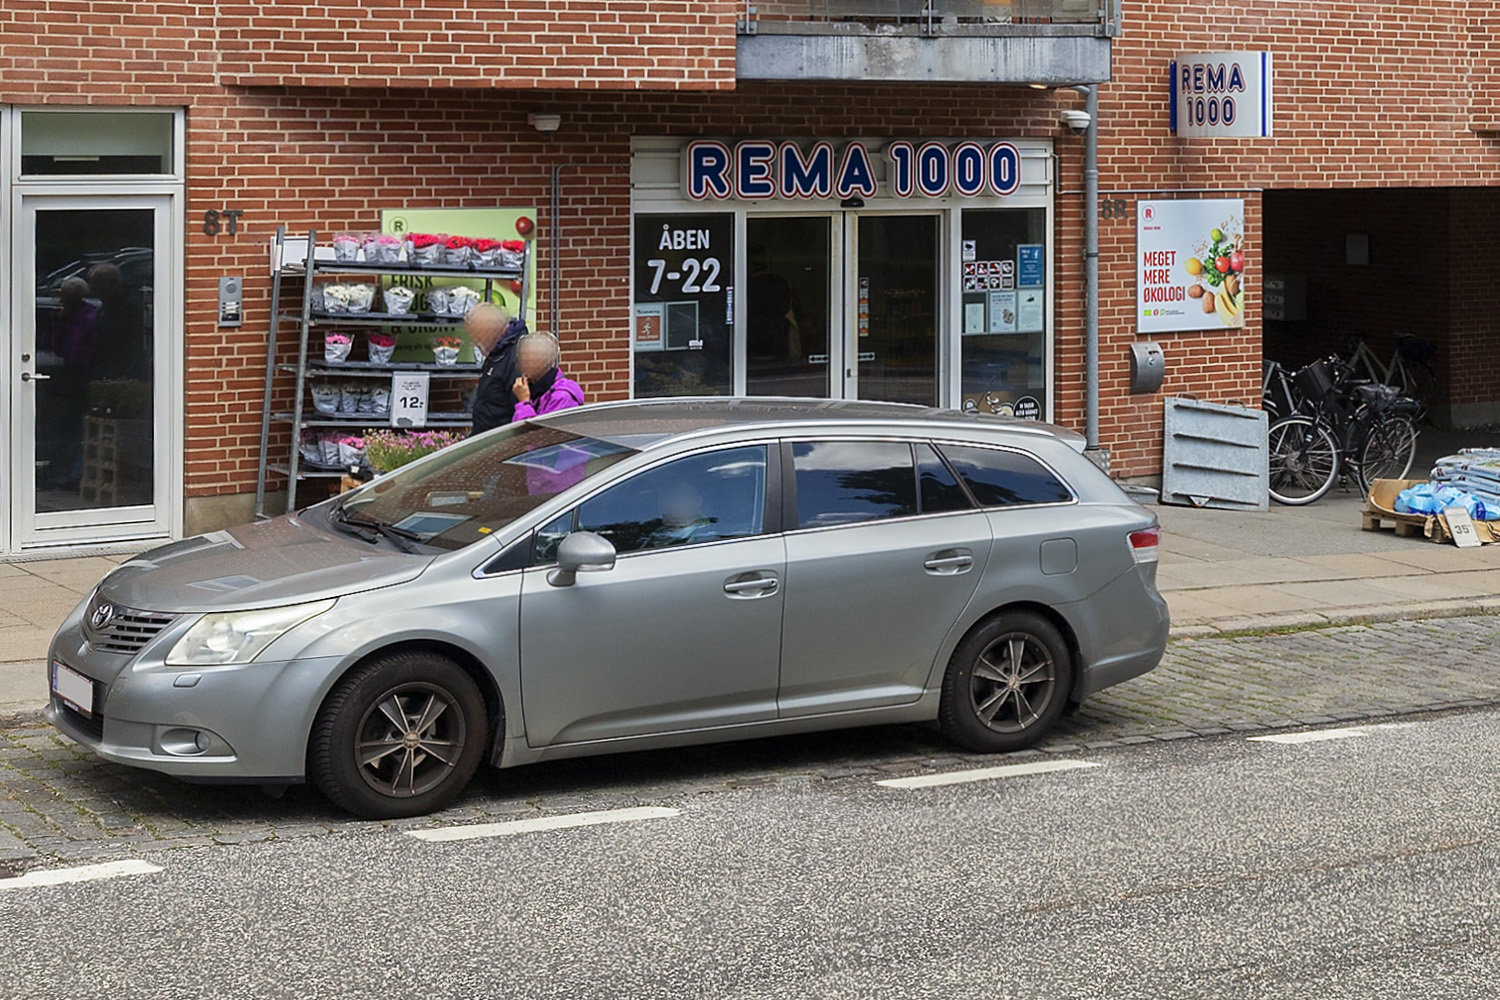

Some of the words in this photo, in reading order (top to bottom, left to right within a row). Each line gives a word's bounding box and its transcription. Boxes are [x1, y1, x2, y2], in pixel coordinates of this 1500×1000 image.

[1181, 63, 1246, 94] REMA
[1187, 96, 1236, 126] 1000
[687, 140, 878, 200] REMA
[889, 141, 1022, 198] 1000
[204, 209, 243, 236] 8T
[659, 223, 710, 250] ÅBEN
[1143, 250, 1176, 267] MEGET
[647, 257, 721, 295] 7-22
[1143, 268, 1170, 284] MERE
[1143, 286, 1186, 303] ØKOLOGI
